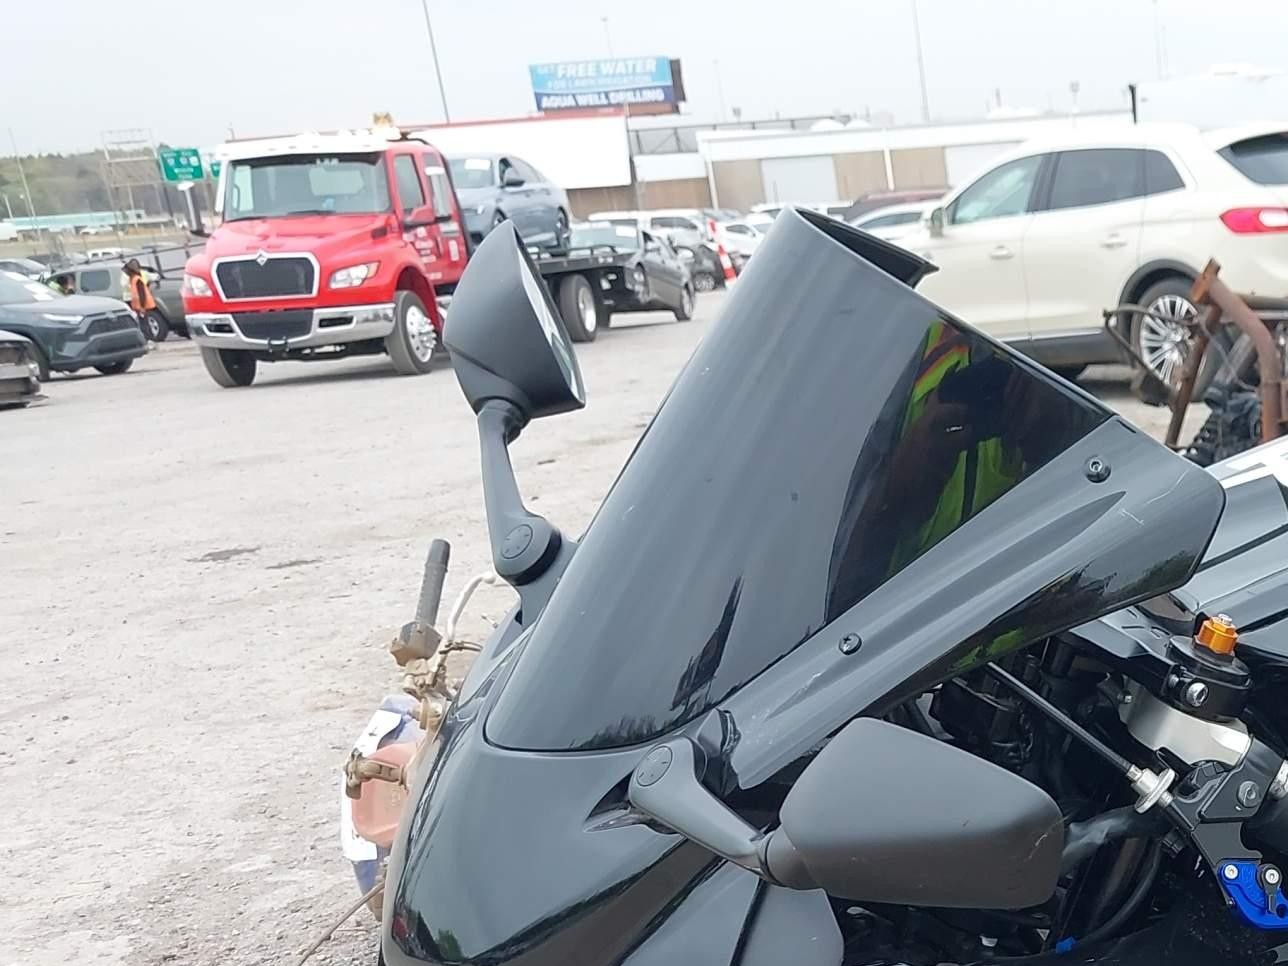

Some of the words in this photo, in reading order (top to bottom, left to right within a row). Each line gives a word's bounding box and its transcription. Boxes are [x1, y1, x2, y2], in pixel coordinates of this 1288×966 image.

[557, 62, 597, 78] FREE
[600, 58, 657, 75] WATER
[541, 94, 576, 109] AQUA
[576, 92, 608, 107] WELL
[608, 88, 665, 104] DRILLING
